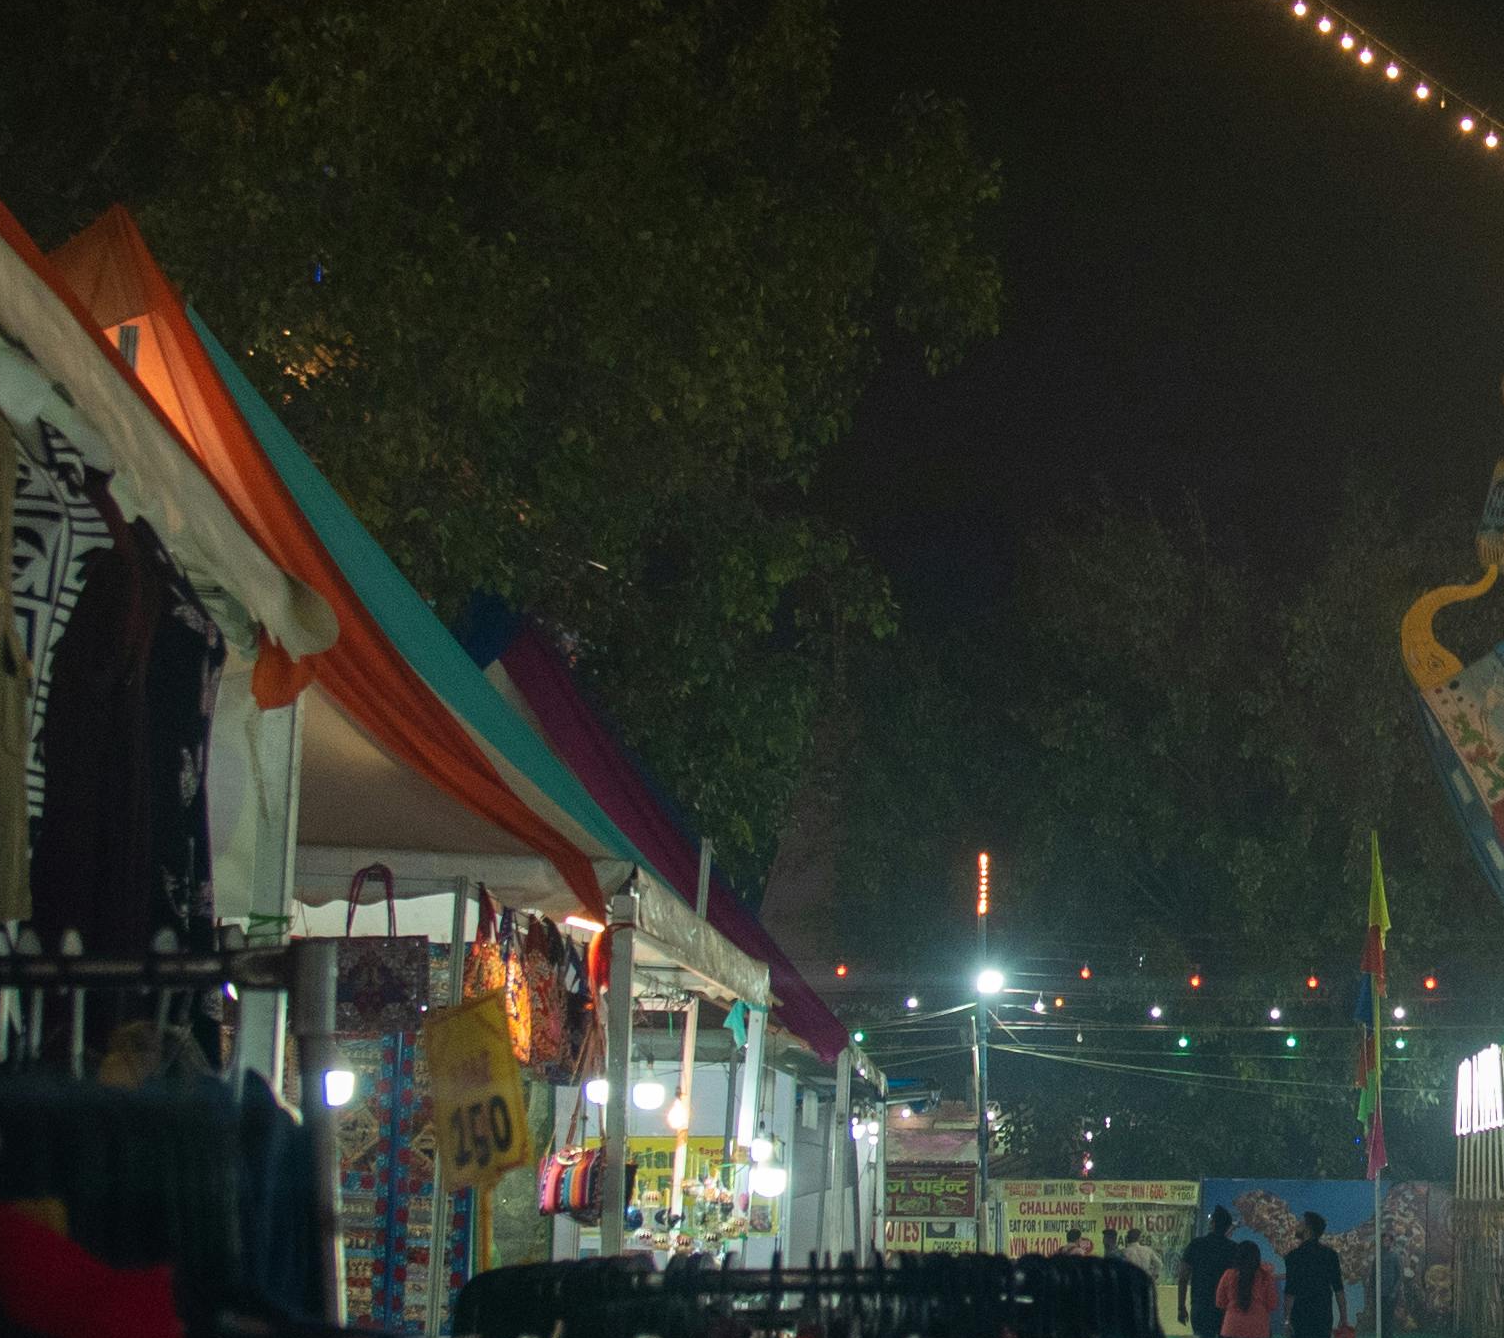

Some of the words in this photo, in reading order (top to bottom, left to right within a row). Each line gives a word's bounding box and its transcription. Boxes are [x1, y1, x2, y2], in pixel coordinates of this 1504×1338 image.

[452, 1095, 512, 1167] 150
[1019, 1201, 1086, 1215] CHALLANGE
[1023, 1220, 1036, 1233] FOR
[1104, 1215, 1133, 1230] WIN
